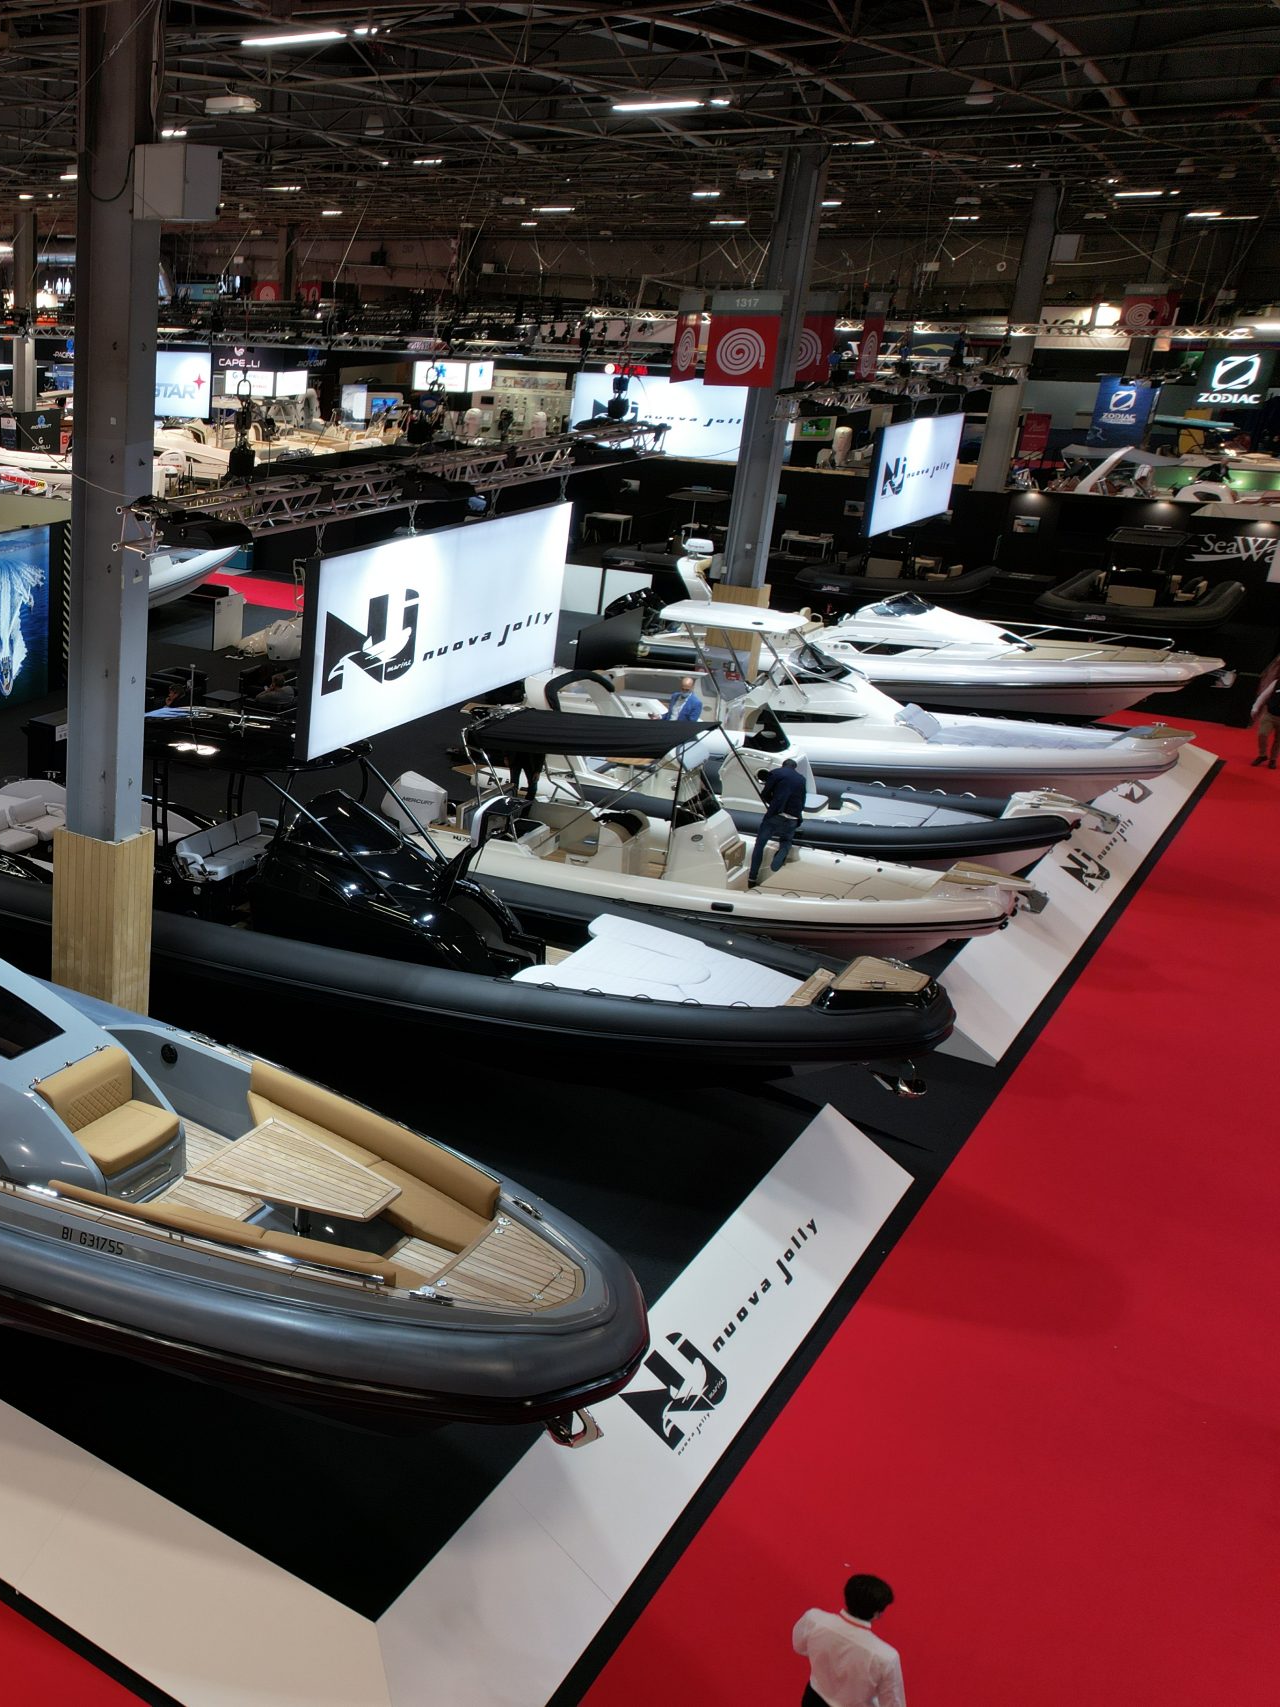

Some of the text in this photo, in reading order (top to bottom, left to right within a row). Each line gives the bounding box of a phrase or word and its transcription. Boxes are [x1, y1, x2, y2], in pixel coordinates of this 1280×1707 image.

[735, 298, 760, 308] 1317
[1197, 392, 1262, 404] ZODIAC
[1102, 412, 1137, 420] ZODIAC
[703, 417, 742, 427] Joll
[907, 468, 929, 478] nuova
[422, 630, 492, 661] nuova
[79, 1233, 125, 1256] G31755
[712, 1278, 772, 1353] nuova
